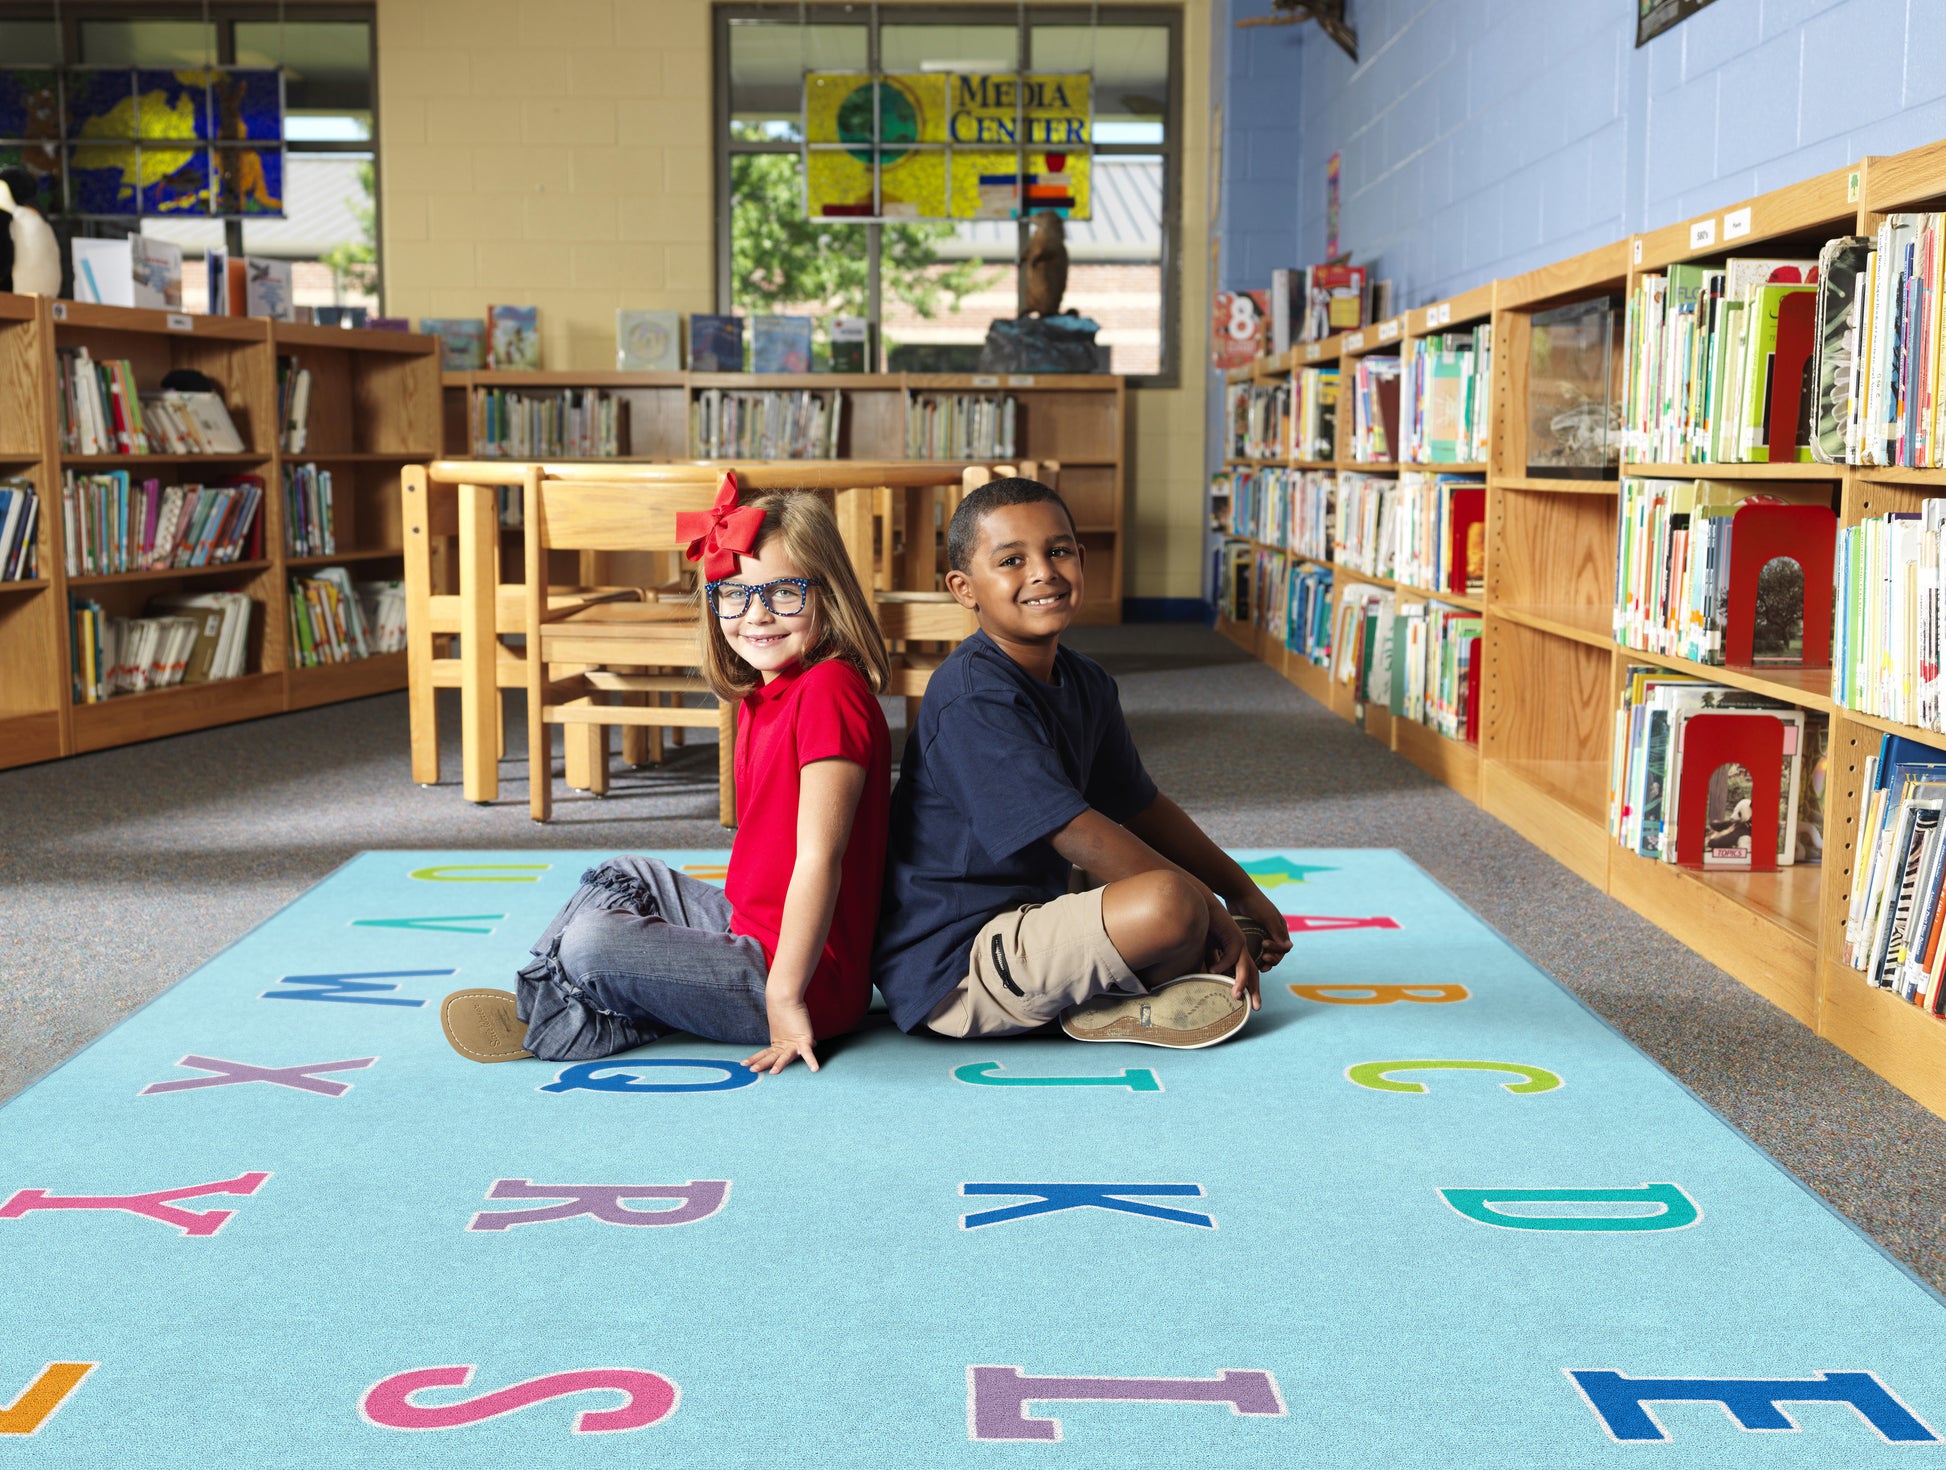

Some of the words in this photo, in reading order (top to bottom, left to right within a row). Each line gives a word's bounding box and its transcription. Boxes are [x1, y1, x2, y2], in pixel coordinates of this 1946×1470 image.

[958, 75, 1070, 107] MEDIA
[950, 110, 1086, 144] CENTER
[1228, 296, 1255, 340] 8
[408, 864, 551, 882] U
[1717, 849, 1743, 857] TOPICS
[350, 914, 506, 935] V
[260, 968, 459, 1009] W
[1291, 985, 1470, 1005] B
[143, 1056, 376, 1096] X
[539, 1059, 760, 1094] Q
[954, 1063, 1162, 1092] J
[1349, 1061, 1562, 1094] C
[0, 1173, 270, 1237] Y
[470, 1180, 730, 1232] R
[963, 1184, 1215, 1230] K
[1441, 1184, 1699, 1232] D
[362, 1367, 677, 1434] S
[973, 1367, 1282, 1440] L
[1570, 1370, 1938, 1443] E
